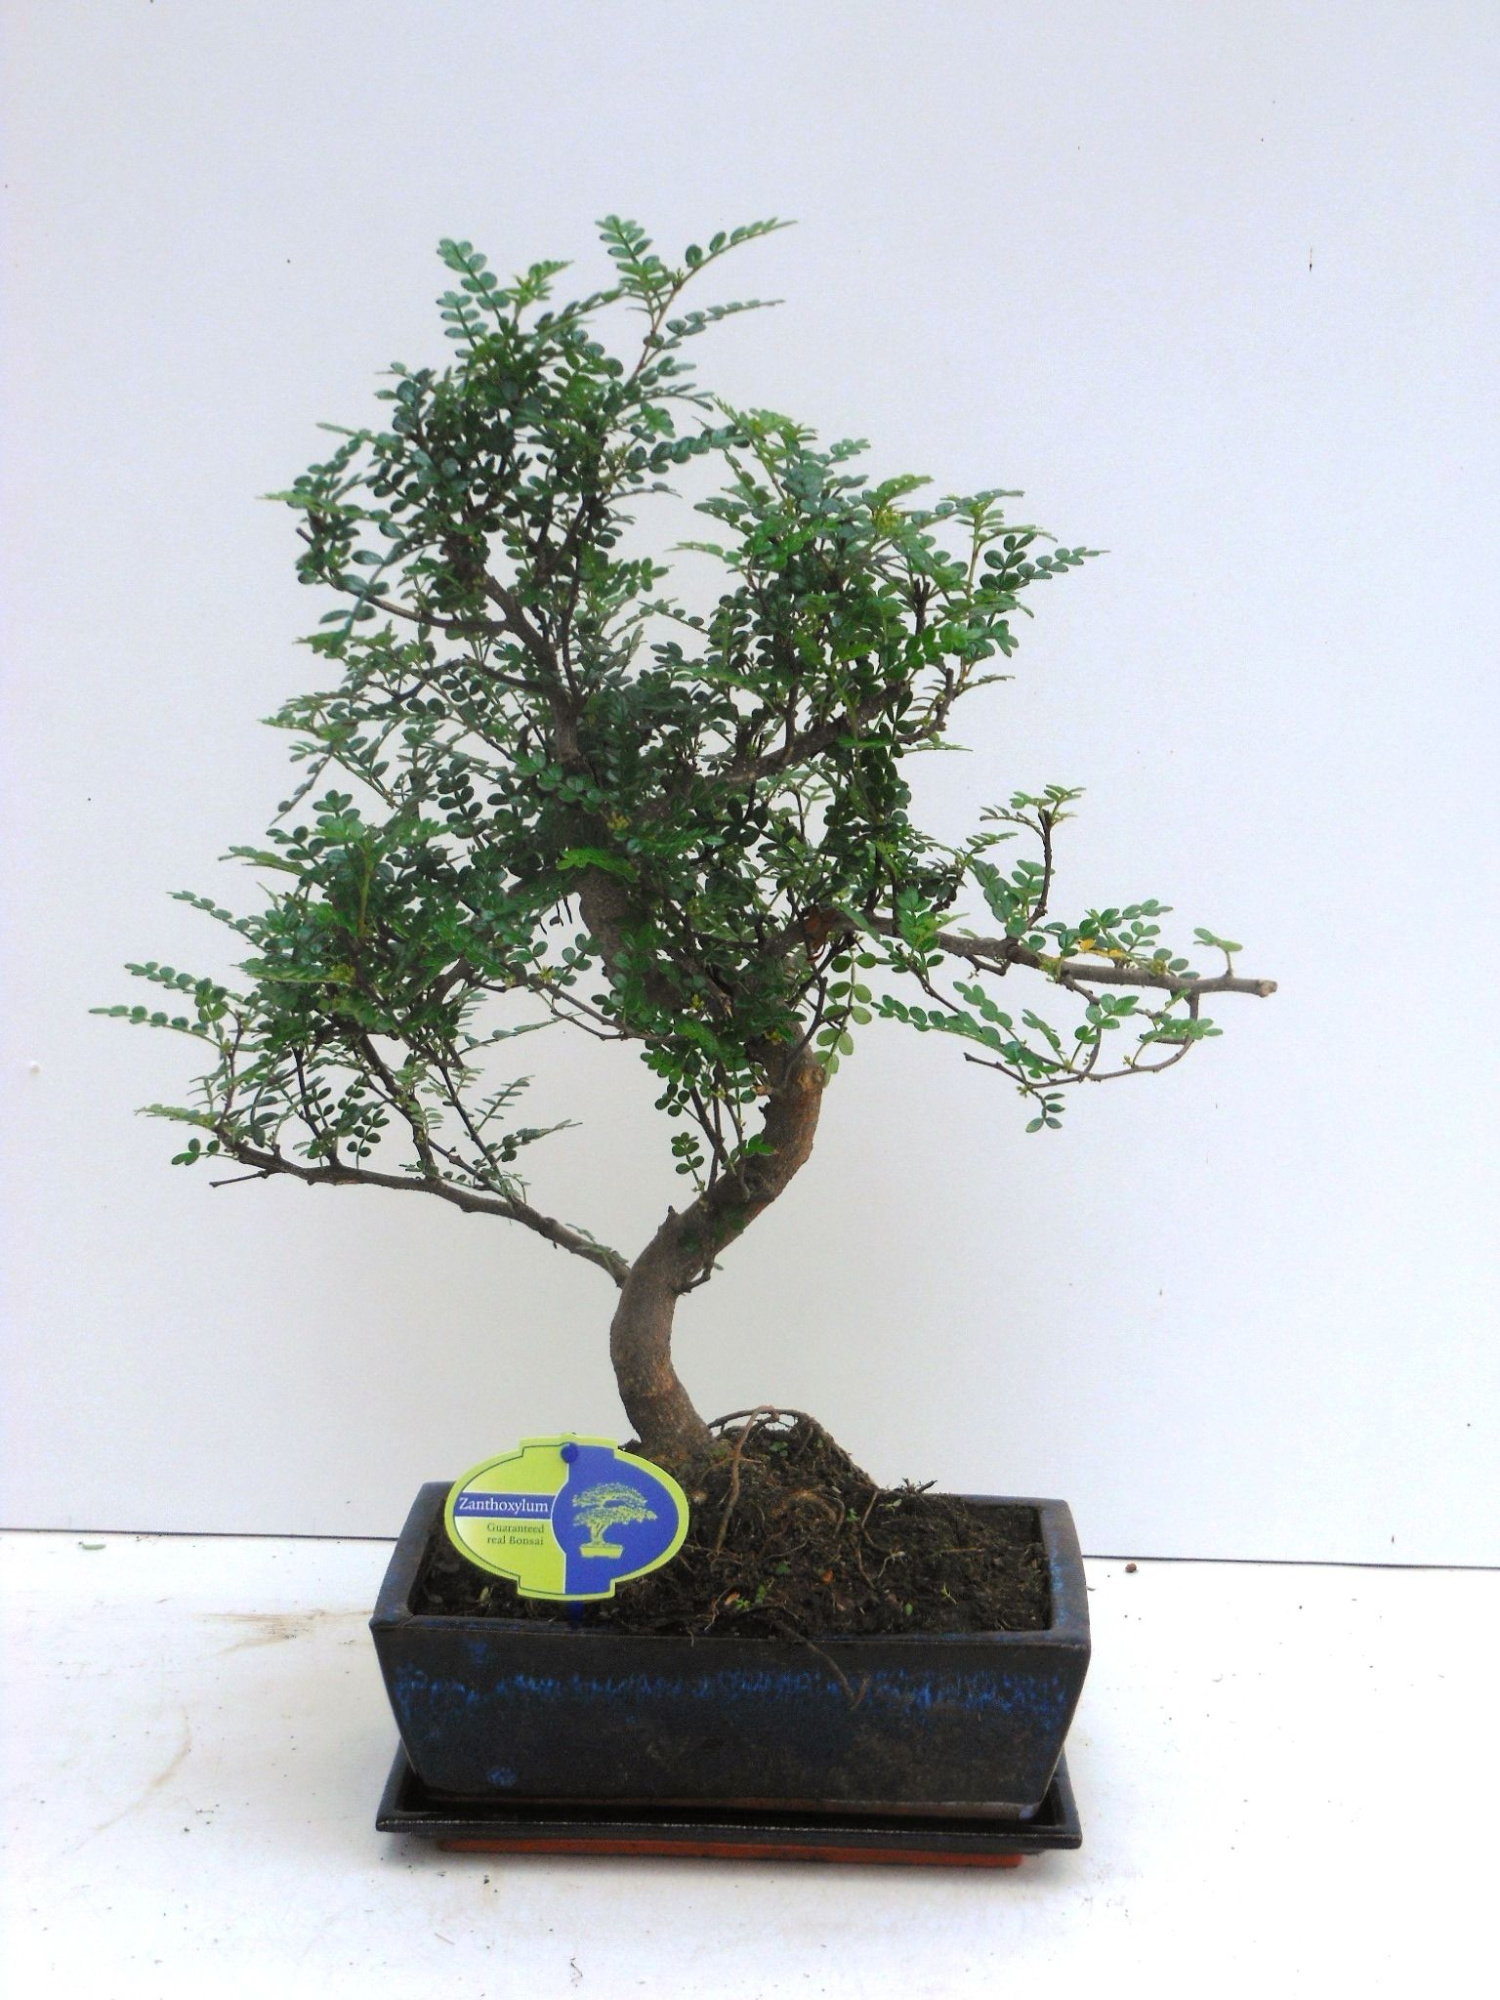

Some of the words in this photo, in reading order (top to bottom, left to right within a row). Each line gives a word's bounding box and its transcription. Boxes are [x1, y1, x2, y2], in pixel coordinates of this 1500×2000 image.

[458, 1497, 549, 1515] Zanthoxylum
[486, 1523, 545, 1533] Guaranteed
[487, 1535, 506, 1545] real
[509, 1535, 544, 1546] Bonsai
